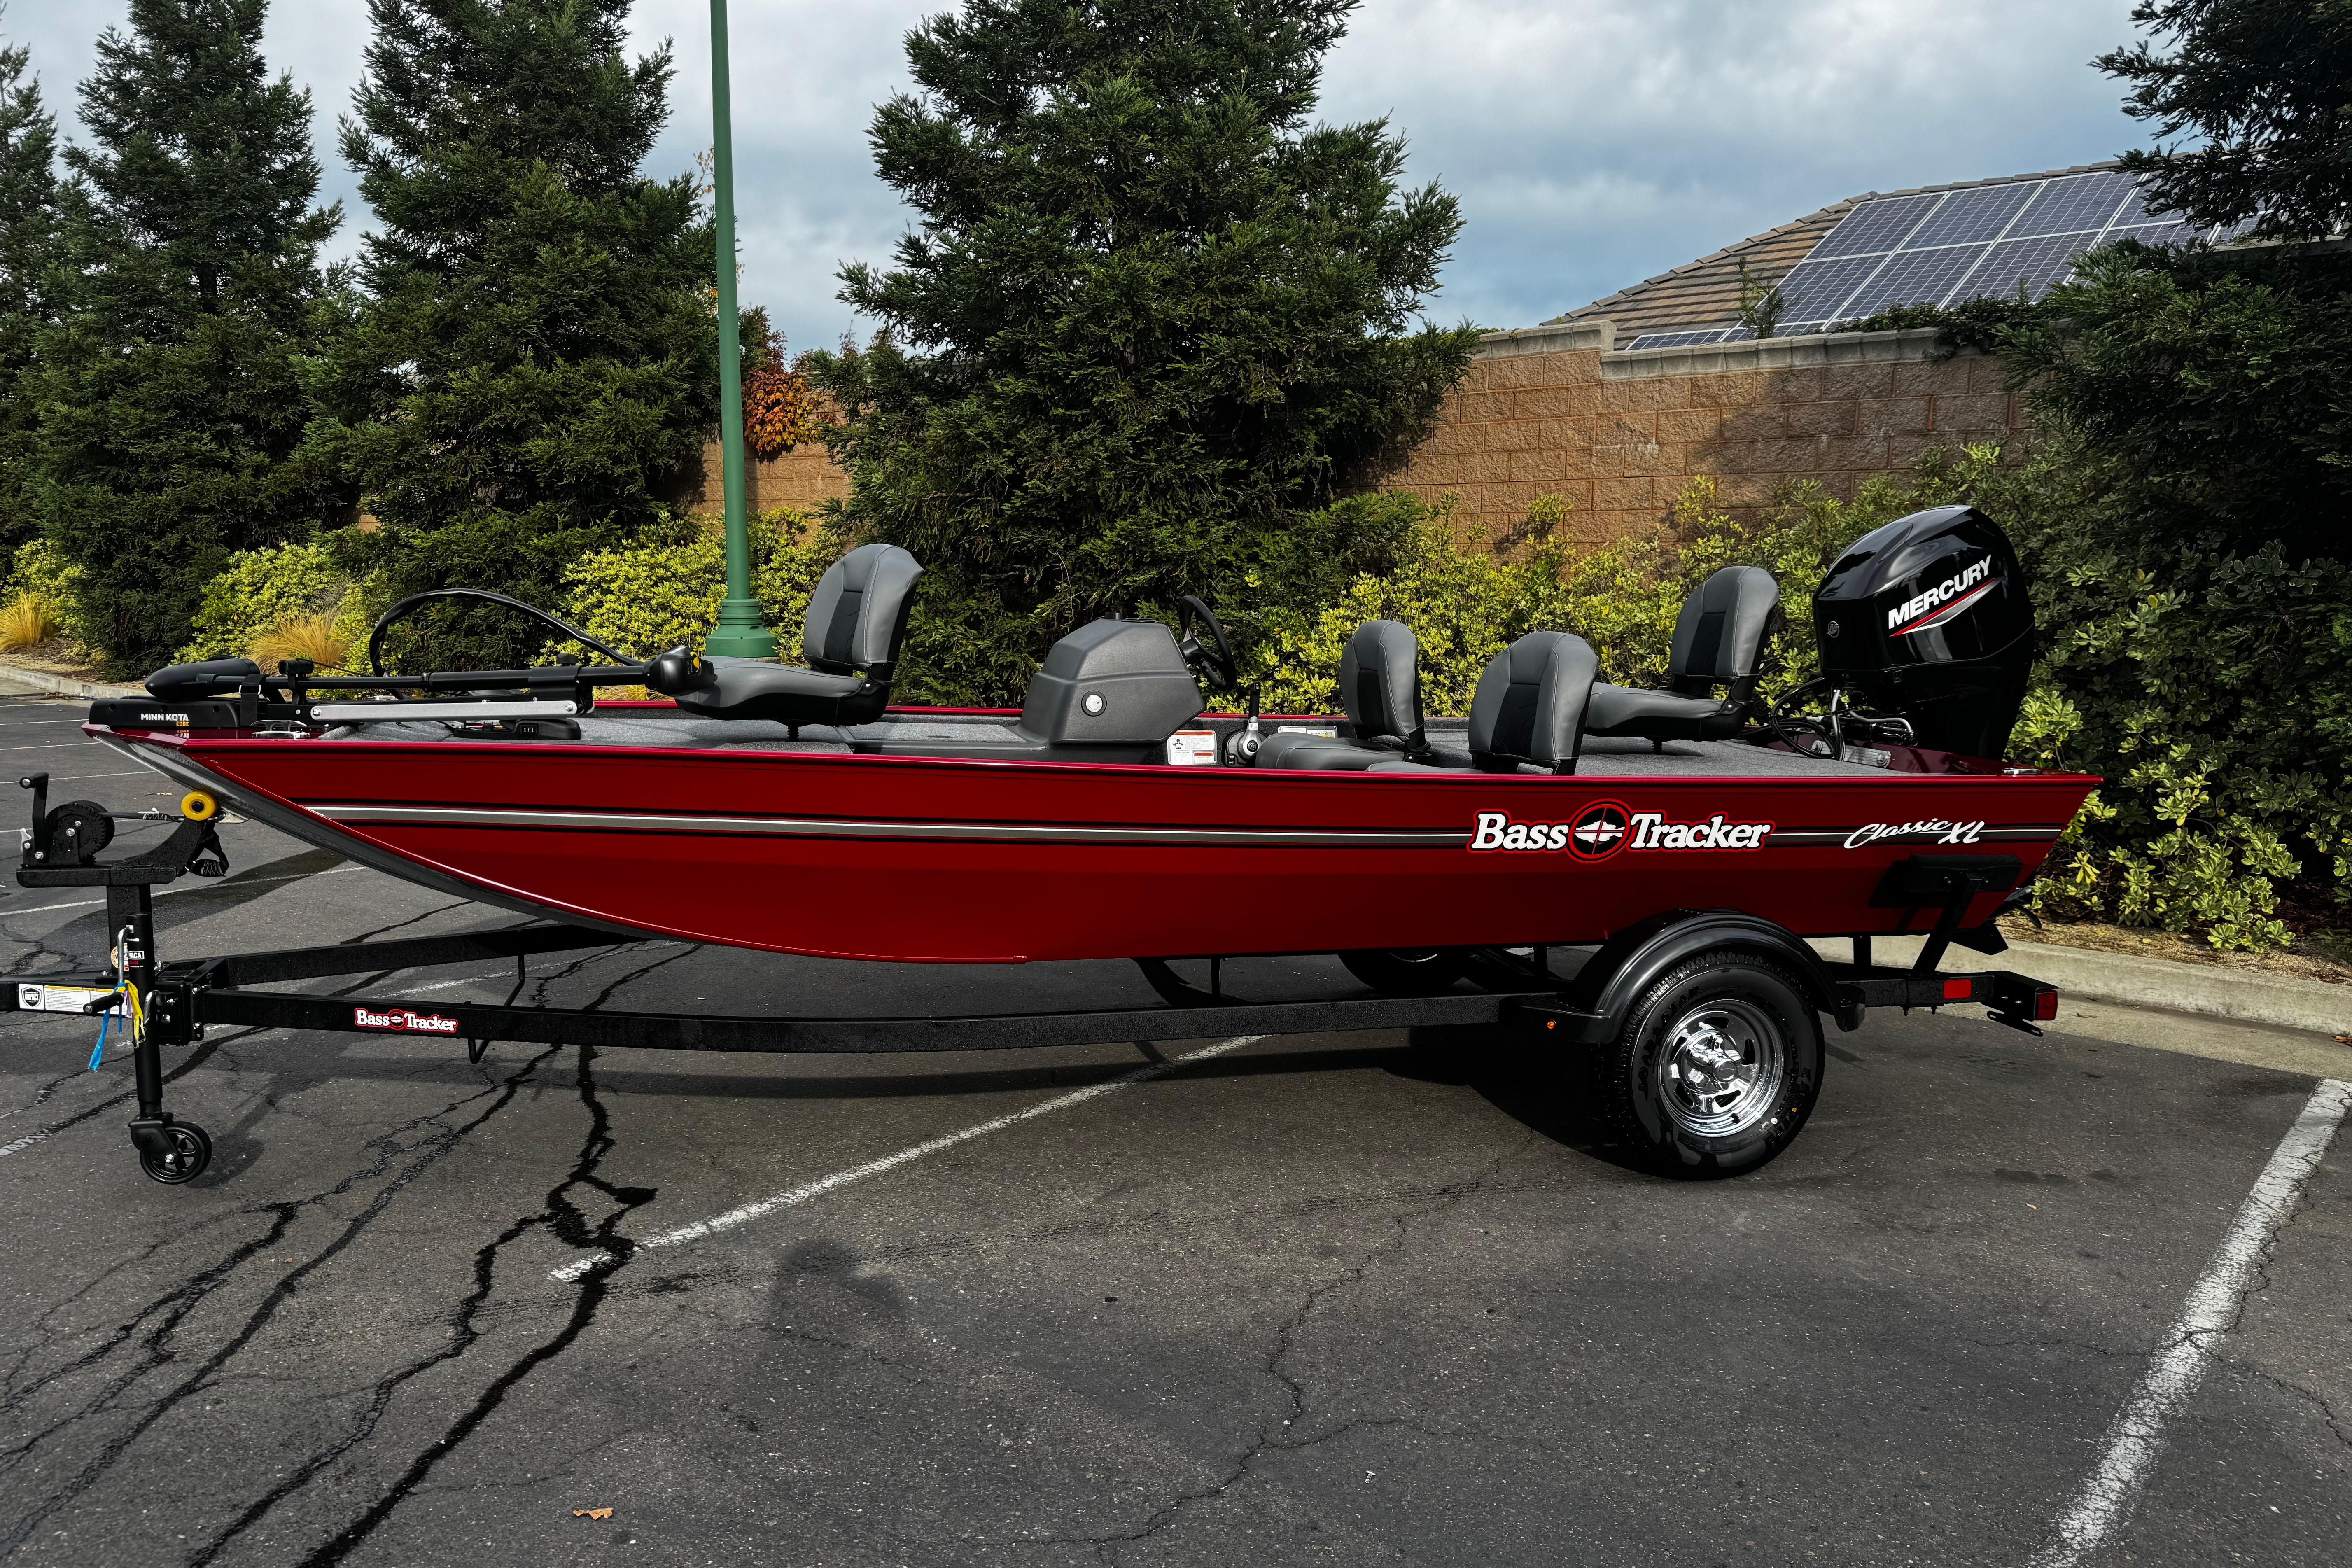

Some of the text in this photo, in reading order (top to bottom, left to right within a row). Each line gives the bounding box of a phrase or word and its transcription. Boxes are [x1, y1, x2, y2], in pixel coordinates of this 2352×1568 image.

[1888, 554, 1992, 630] MERCURY
[1471, 813, 1771, 849] Bass Tracker
[1843, 818, 1985, 849] Classic XL
[356, 1010, 457, 1031] Bass Tracker
